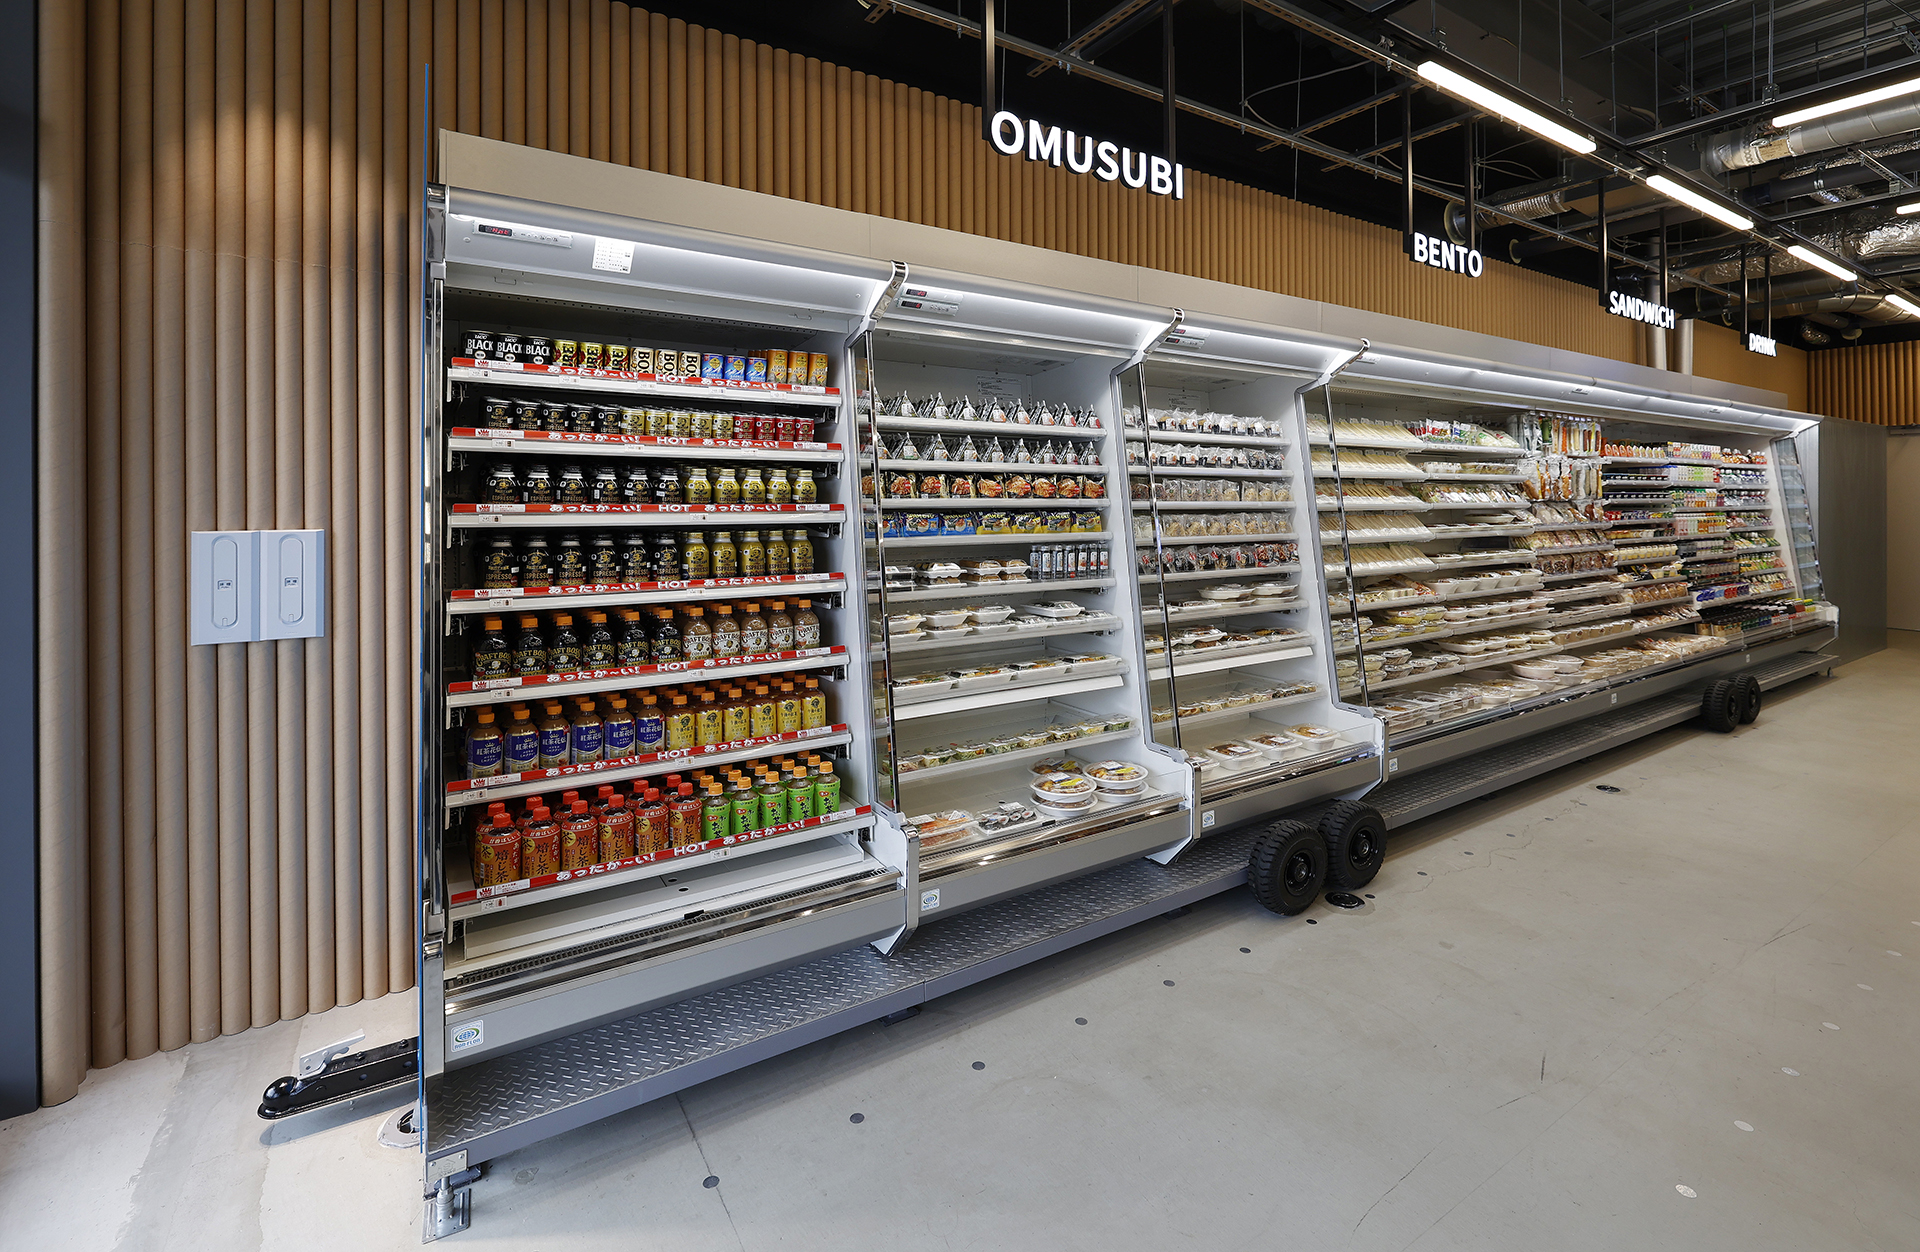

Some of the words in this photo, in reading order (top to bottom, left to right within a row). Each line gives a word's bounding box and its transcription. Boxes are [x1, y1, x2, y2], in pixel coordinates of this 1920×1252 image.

[991, 110, 1184, 199] OMUSUBI
[1414, 231, 1483, 278] BENTO
[1609, 290, 1675, 330] SANDWICH
[467, 339, 493, 351] BLACK
[497, 342, 522, 354] BLACK
[526, 344, 551, 356] BLACK
[1749, 332, 1777, 357] DRINK
[562, 346, 574, 367] IRE
[587, 348, 598, 369] IRE
[612, 350, 625, 371] IRE
[655, 374, 688, 385] HOT
[656, 436, 690, 446] HOT
[658, 504, 692, 512] HOT
[657, 580, 691, 589] HOT
[743, 632, 759, 643] CRAFT
[770, 629, 789, 640] CRAFT
[799, 627, 816, 638] CRAFT
[684, 636, 702, 648] CRAFT
[713, 634, 731, 646] CRAFT
[657, 661, 691, 672] HOT
[657, 748, 691, 760] HOT
[684, 815, 695, 844] 焙じ茶
[651, 821, 662, 852] 焙じ茶
[612, 828, 625, 859] 焙じ茶
[674, 841, 709, 856] HOT
[576, 835, 590, 867] 焙じ茶
[536, 842, 549, 875] 焙じ茶
[495, 849, 510, 883] 焙じ茶
